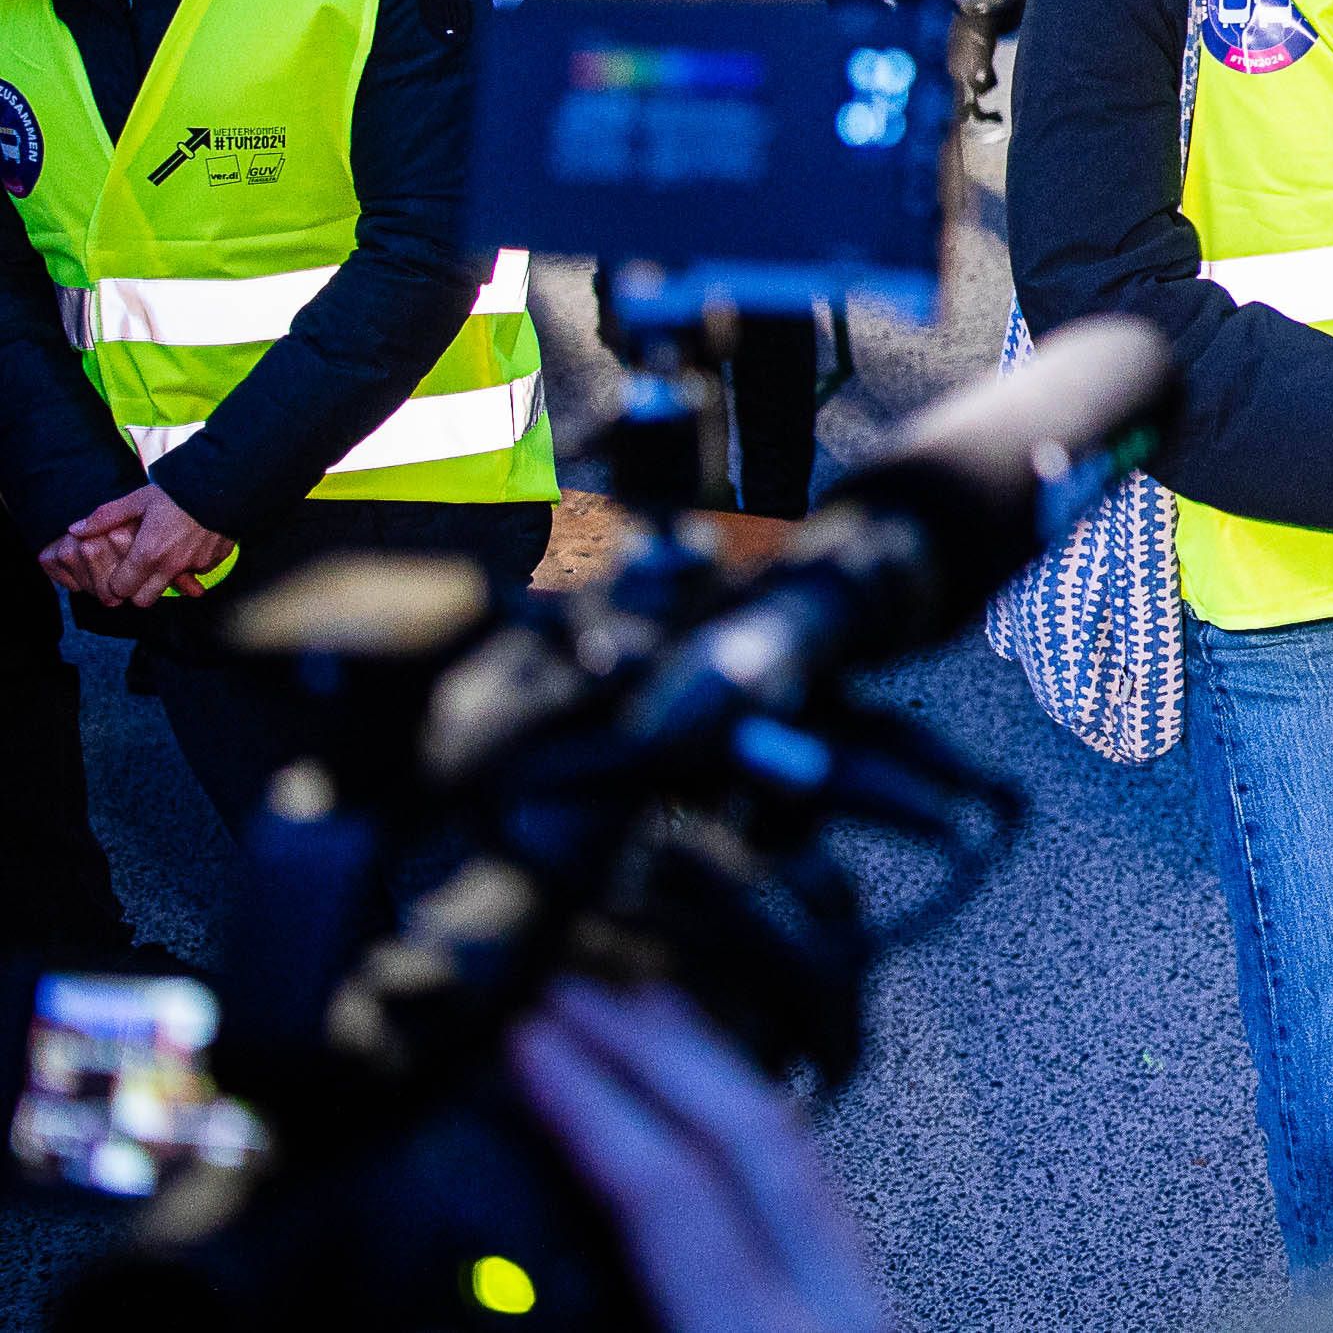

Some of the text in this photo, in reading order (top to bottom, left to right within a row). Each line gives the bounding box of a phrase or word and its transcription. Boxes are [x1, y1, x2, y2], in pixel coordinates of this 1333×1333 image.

[213, 126, 286, 137] WEITERKOMMEN
[214, 135, 286, 151] #TUN2024
[210, 172, 239, 181] ver.di
